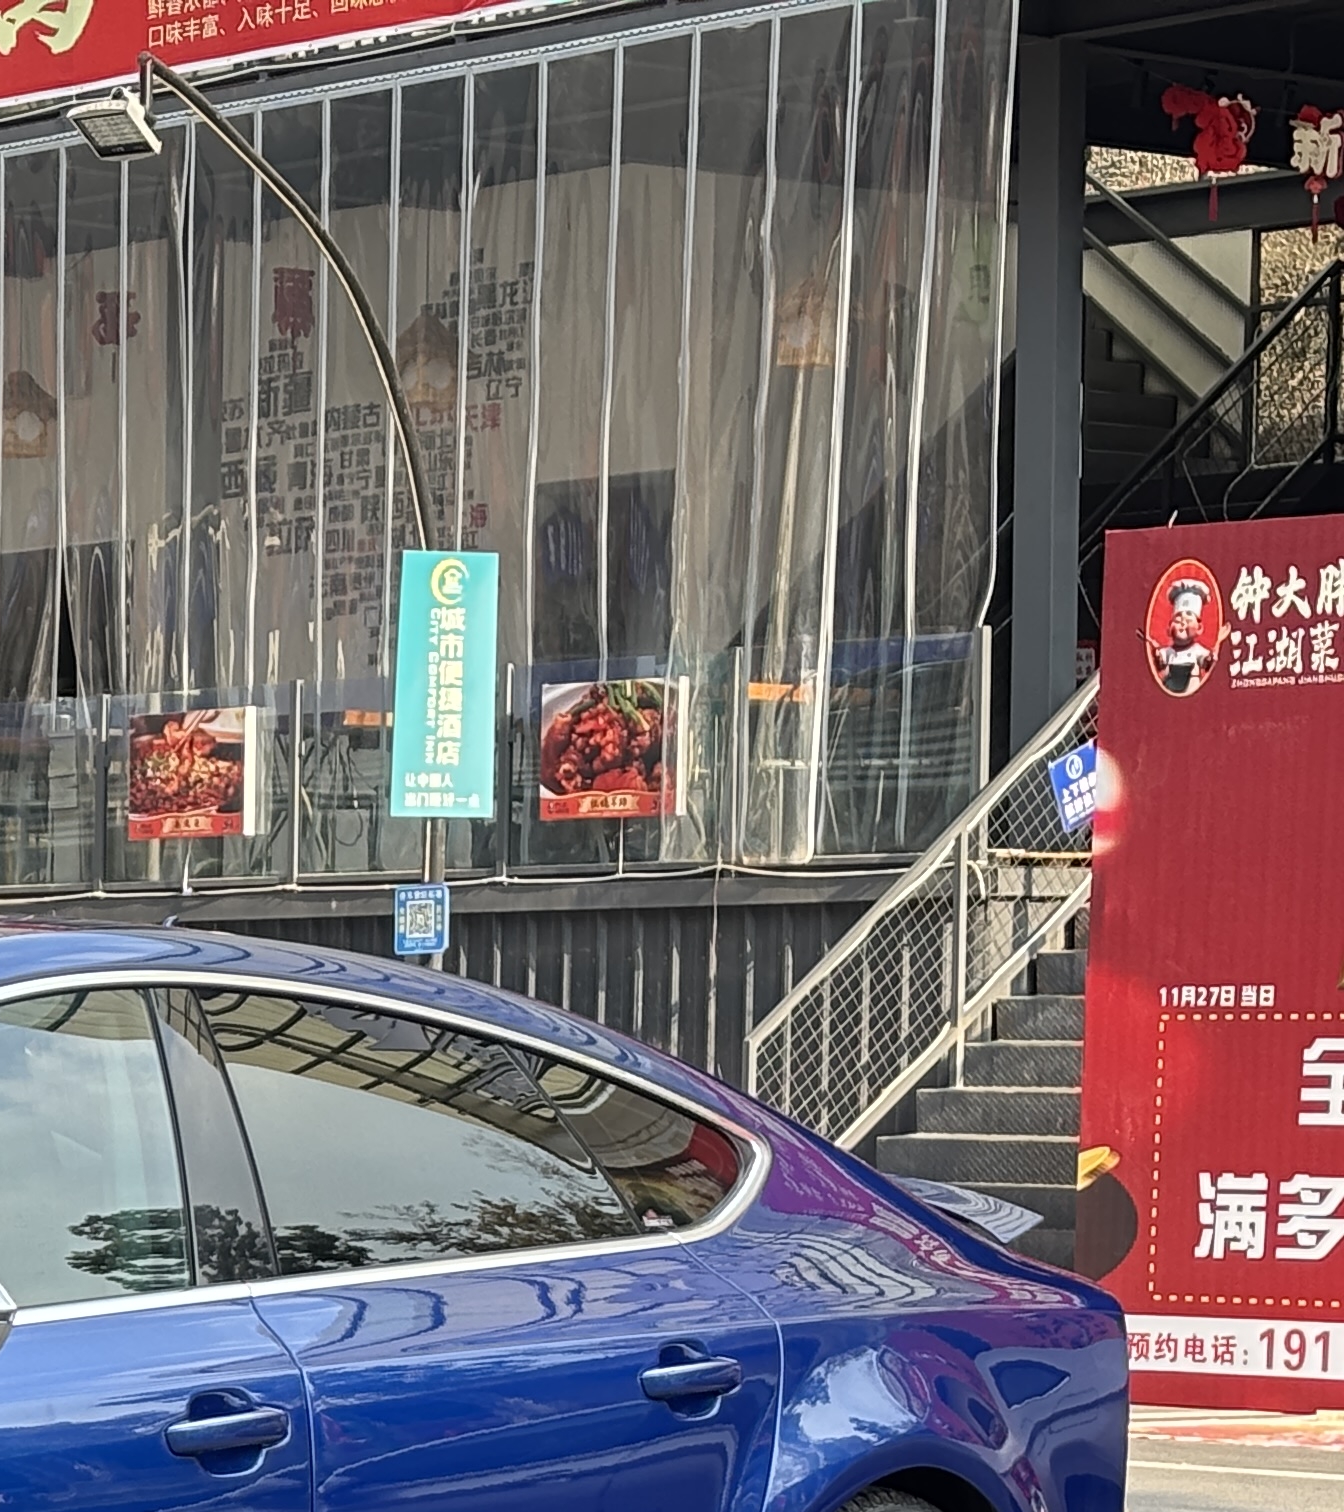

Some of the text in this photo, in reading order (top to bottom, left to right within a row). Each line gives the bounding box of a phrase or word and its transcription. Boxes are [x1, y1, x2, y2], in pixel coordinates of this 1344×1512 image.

[1230, 557, 1344, 624] 钟大胖
[429, 608, 441, 646] CITY
[436, 606, 466, 766] 城市便捷酒店
[1158, 985, 1275, 1008] 11月27日 当日
[1194, 1171, 1344, 1260] 满多
[1258, 1327, 1332, 1373] 191
